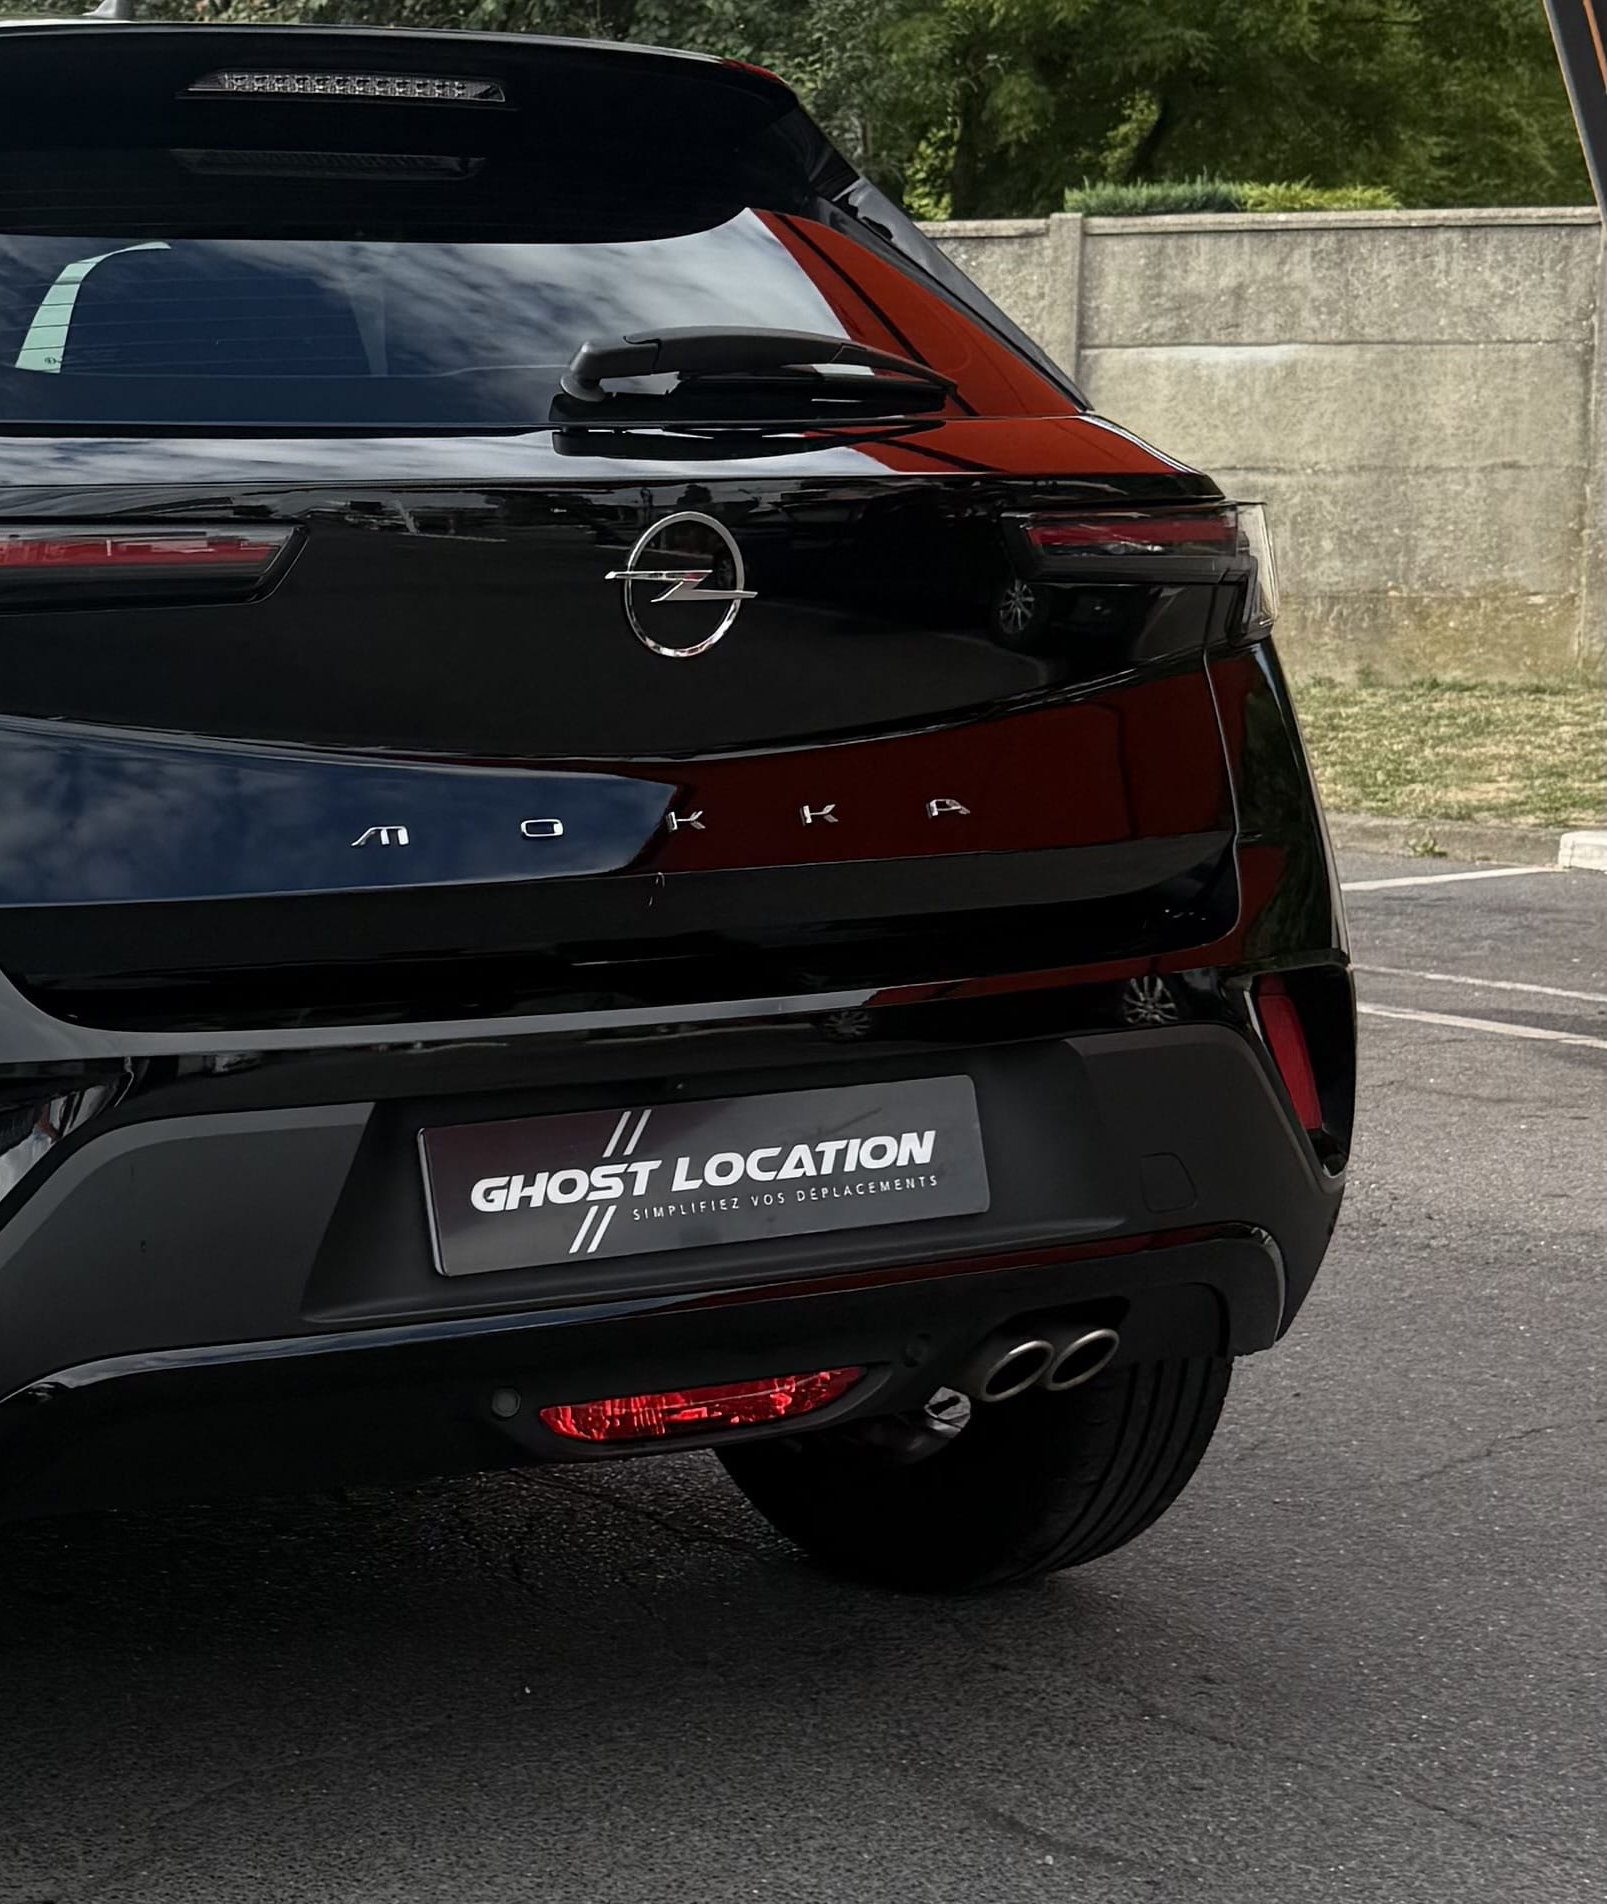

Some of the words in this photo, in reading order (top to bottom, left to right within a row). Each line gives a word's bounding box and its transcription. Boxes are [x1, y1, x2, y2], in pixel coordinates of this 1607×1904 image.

[350, 797, 972, 848] MOKKA
[470, 1159, 662, 1213] GHOST
[671, 1129, 937, 1192] LOCATION
[632, 1197, 740, 1221] SIMPLIFIEZ
[750, 1192, 786, 1207] VOS
